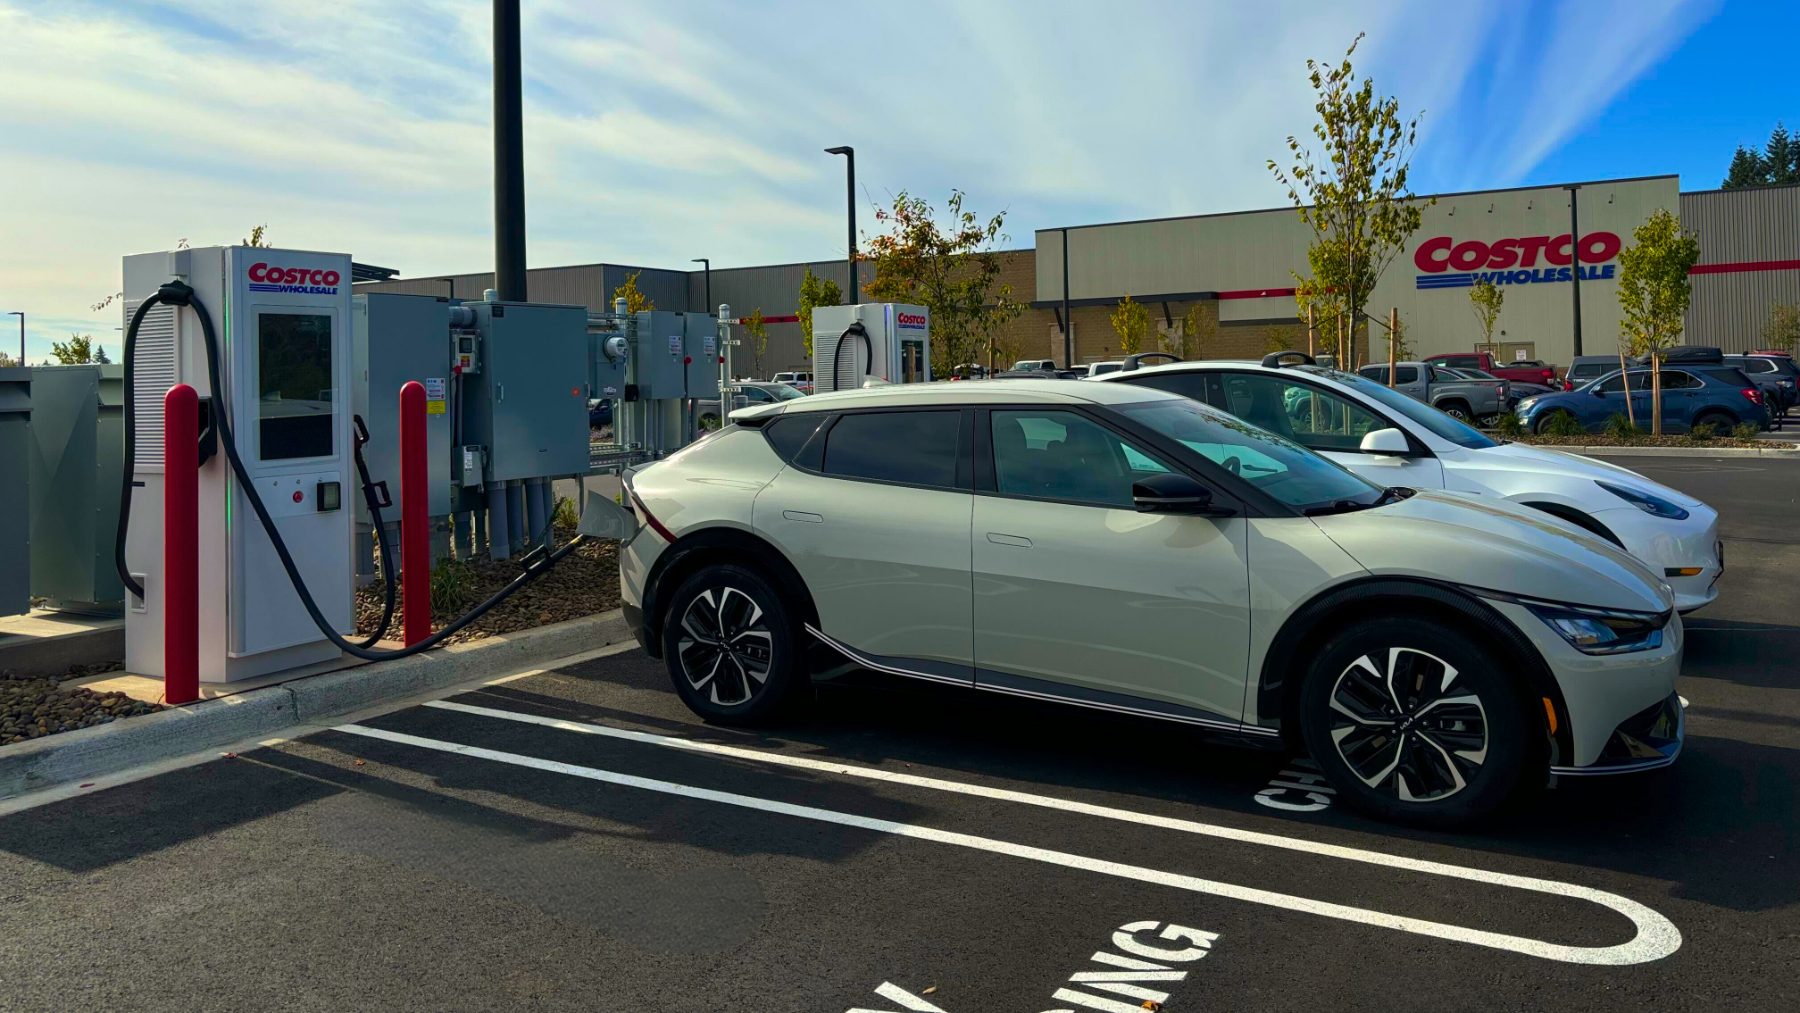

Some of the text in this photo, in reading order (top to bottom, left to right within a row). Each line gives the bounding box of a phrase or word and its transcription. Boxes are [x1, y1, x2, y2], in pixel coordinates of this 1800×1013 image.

[1414, 231, 1621, 273] COSTCO
[248, 262, 340, 286] COSTCO
[279, 285, 338, 295] WHOLESALE
[898, 312, 925, 324] COSTCO
[1037, 920, 1221, 1013] ING
